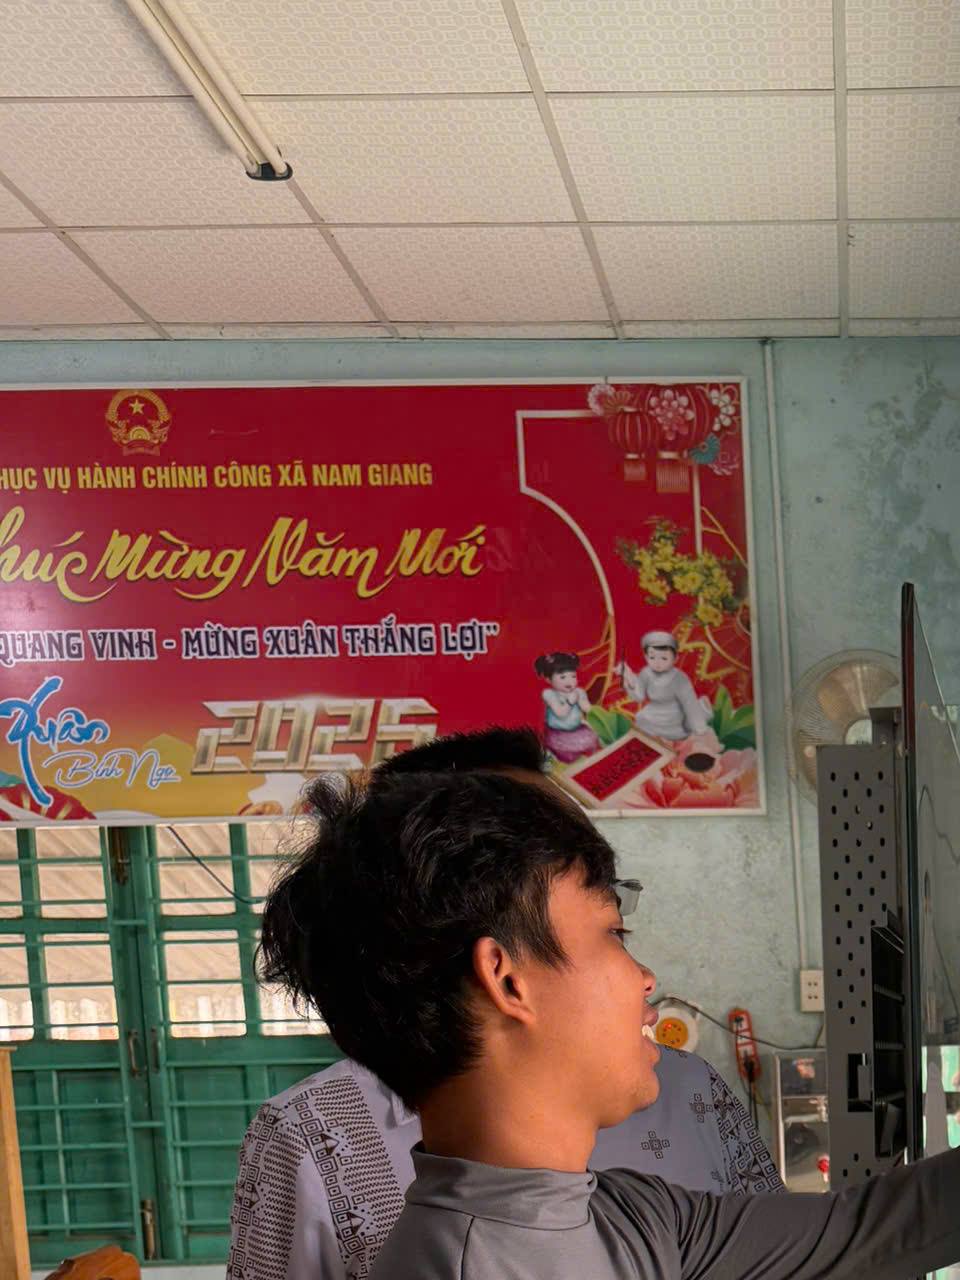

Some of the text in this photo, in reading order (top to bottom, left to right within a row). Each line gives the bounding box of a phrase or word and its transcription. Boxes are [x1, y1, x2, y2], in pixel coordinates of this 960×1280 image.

[43, 467, 71, 494] VỤ
[77, 462, 136, 489] HÀNH
[142, 461, 208, 488] CHÍNH
[213, 461, 272, 488] CÔNG
[278, 460, 306, 487] XÃ
[312, 463, 362, 487] NAM
[368, 463, 433, 486] GIANG
[89, 529, 247, 600] Mừng
[242, 516, 395, 600] Năm
[385, 525, 487, 577] Mới
[88, 628, 157, 660] VINH
[182, 621, 259, 659] MỪNG
[264, 620, 339, 657] XUÂN
[344, 614, 436, 656] THẮNG
[0, 675, 110, 807] Xuân
